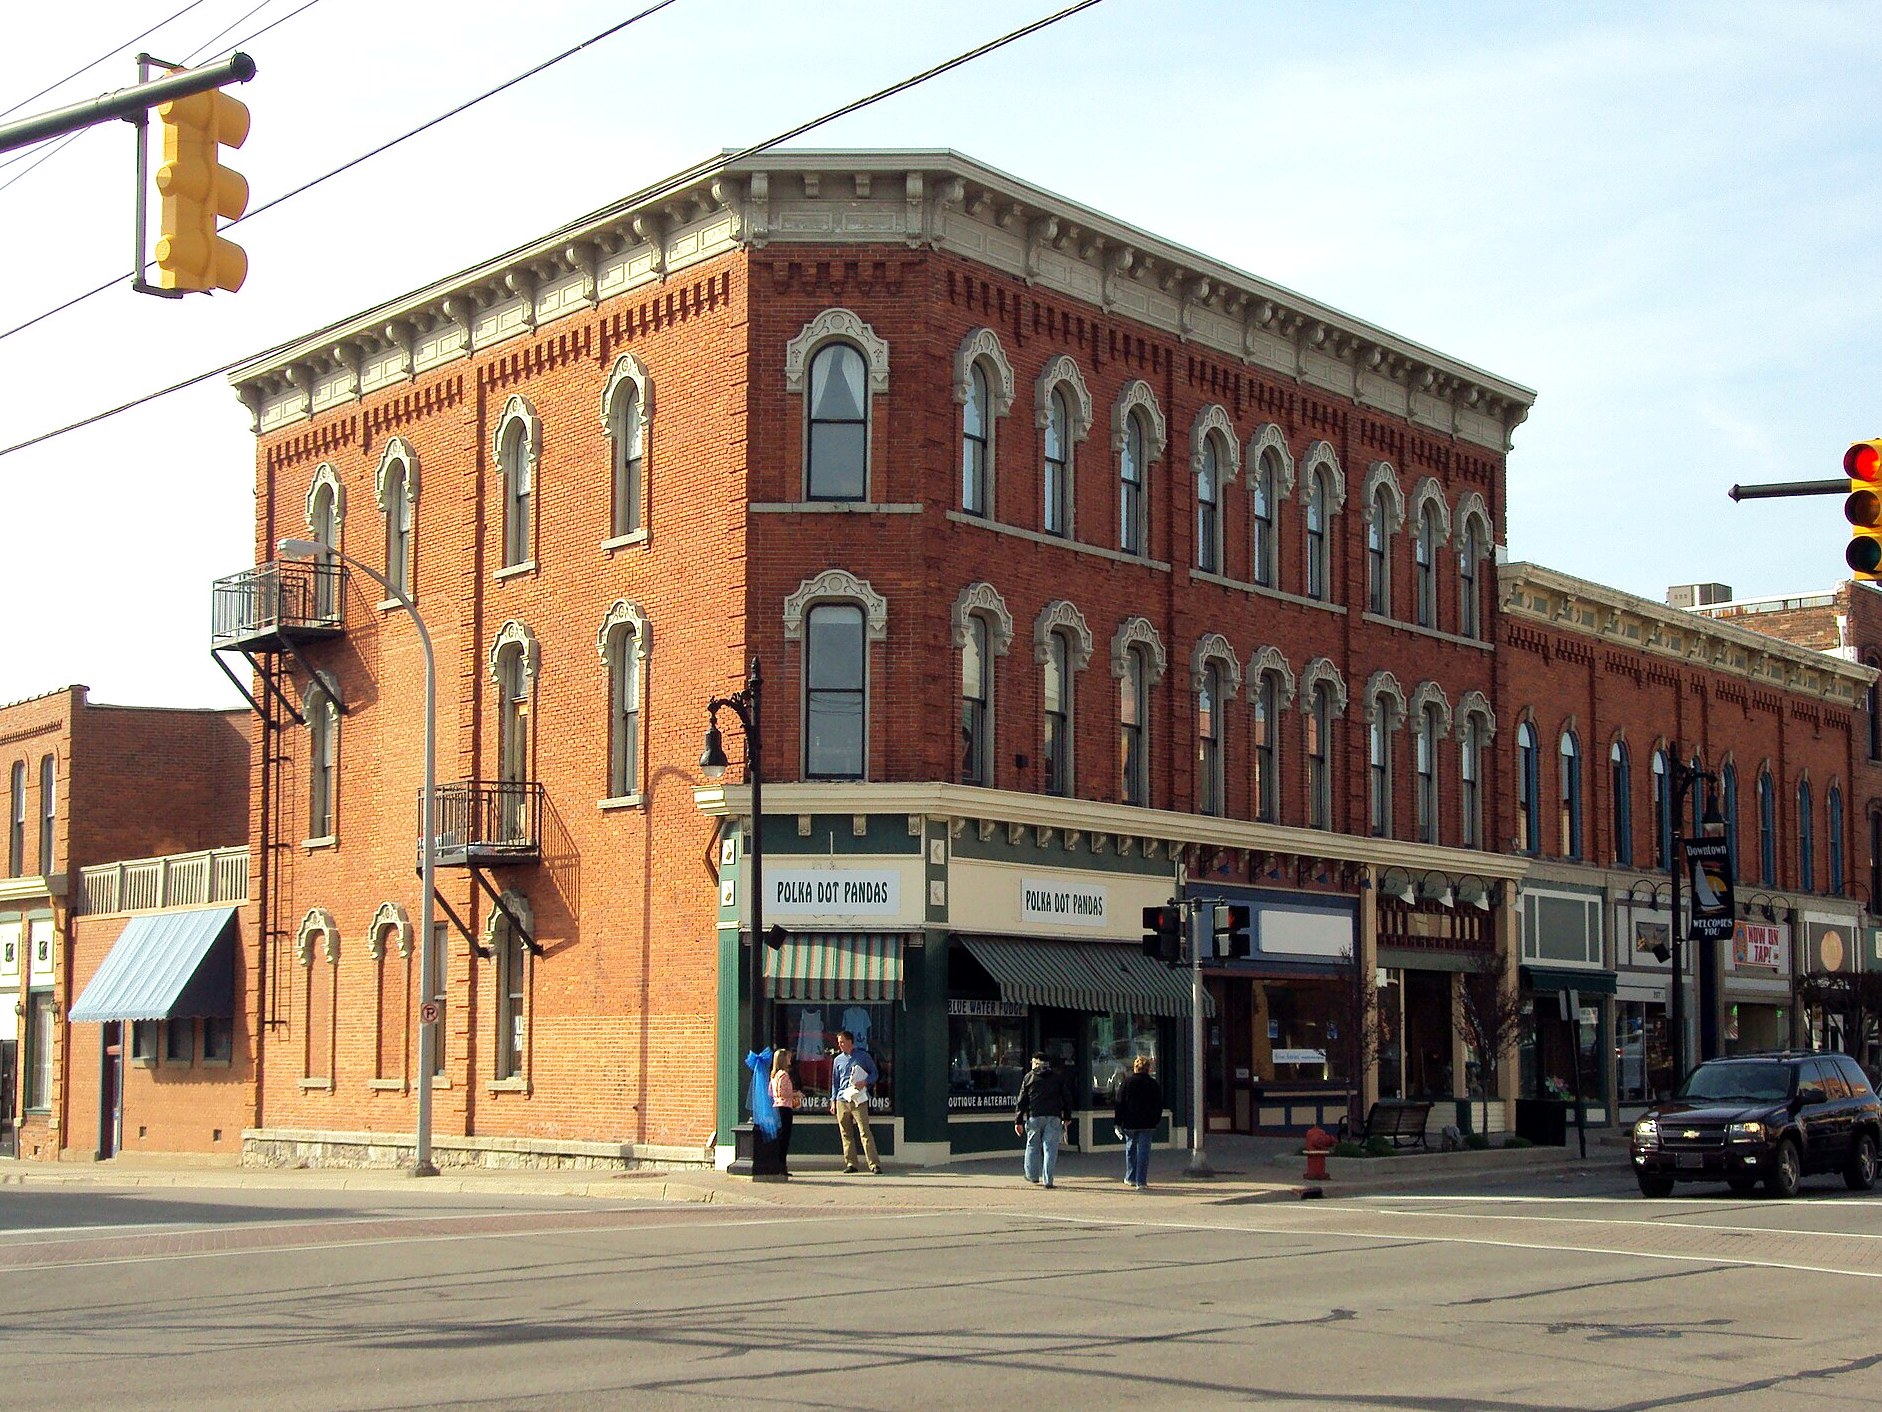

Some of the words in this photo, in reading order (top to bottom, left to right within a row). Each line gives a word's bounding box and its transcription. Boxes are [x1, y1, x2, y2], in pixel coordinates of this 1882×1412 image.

[1686, 845, 1727, 856] Downtown
[777, 881, 812, 903] POLKA
[817, 881, 839, 903] DOT
[844, 881, 888, 903] PANDAS
[1026, 890, 1051, 912] POLKA
[1055, 892, 1069, 914] DOT
[1073, 894, 1103, 916] PANDAS
[1693, 918, 1733, 928] WELCOMES
[1704, 928, 1720, 936] YOU
[1748, 926, 1765, 944] NOW
[1768, 928, 1778, 946] ON
[1754, 945, 1771, 963] TAP!
[948, 1000, 966, 1014] BLUE
[970, 1001, 996, 1014] WATER
[999, 1001, 1023, 1016] FUDGE
[948, 1096, 976, 1107] OUTIQUE
[983, 1096, 1017, 1107] ALTERATIO
